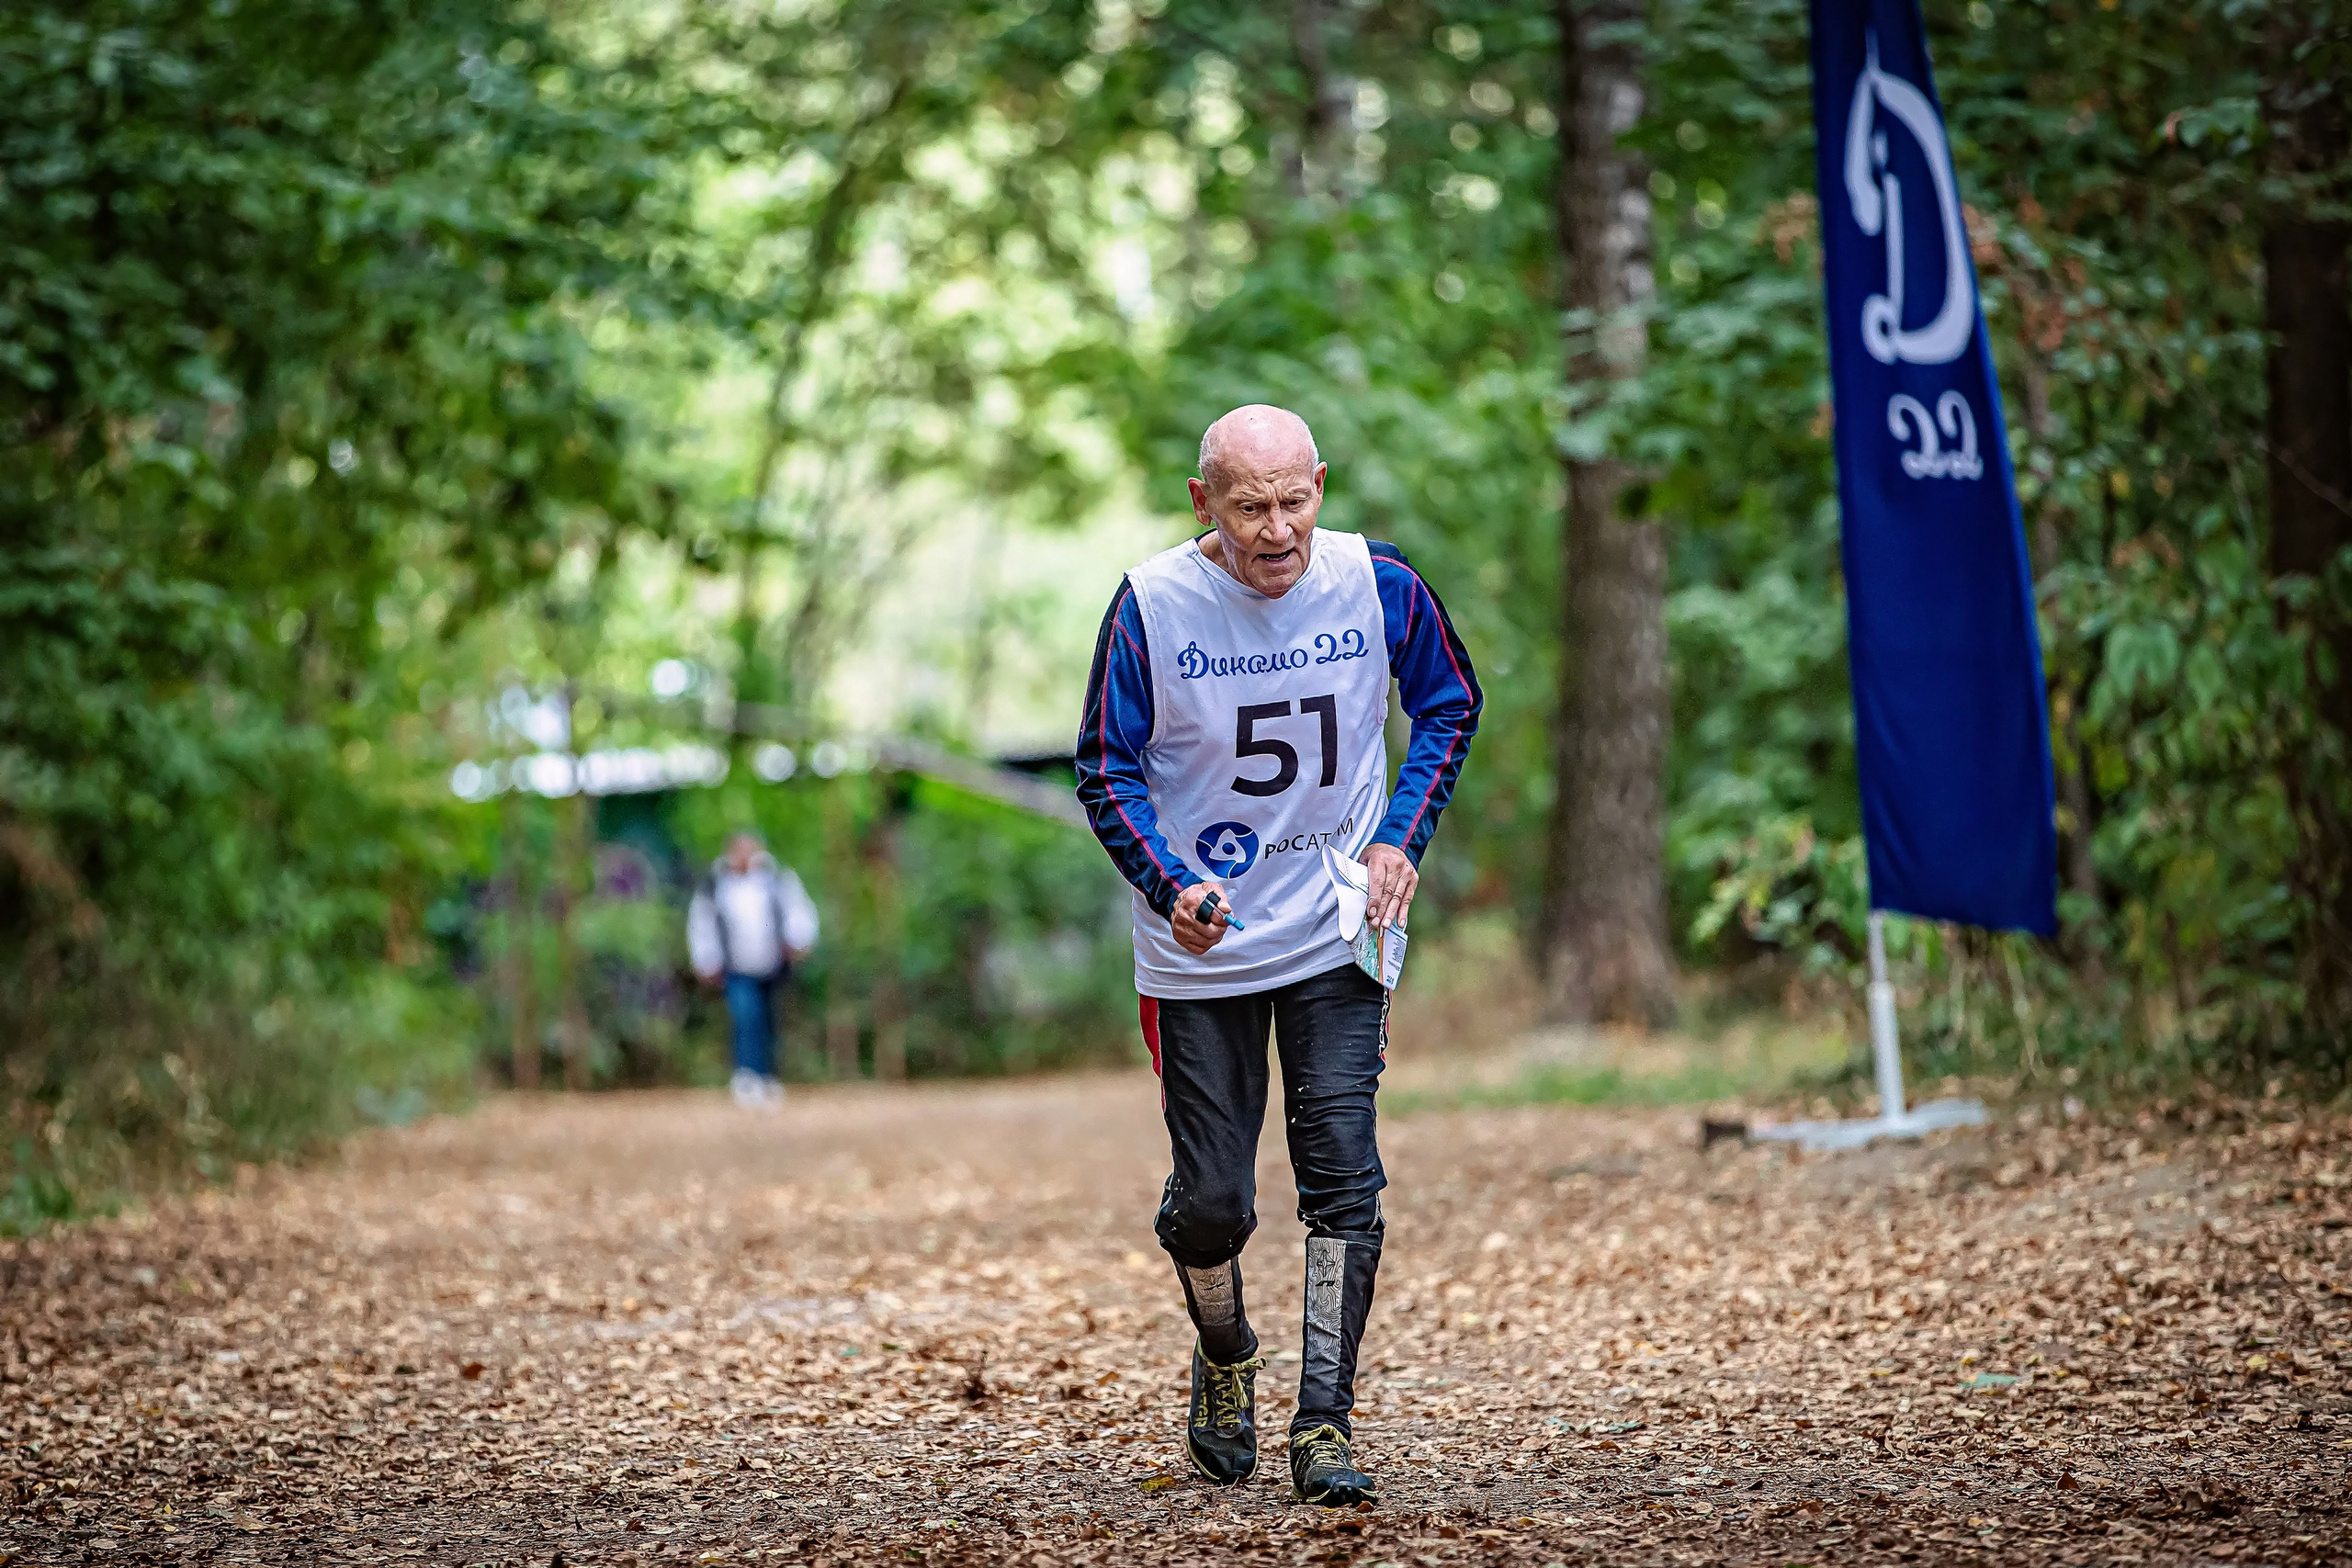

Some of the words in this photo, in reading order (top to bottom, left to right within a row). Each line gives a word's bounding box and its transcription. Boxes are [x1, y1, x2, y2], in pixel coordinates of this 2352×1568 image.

[1887, 389, 1984, 479] 22
[1177, 640, 1308, 680] Динамо
[1314, 628, 1370, 665] 22
[1230, 694, 1339, 797] 51
[1264, 817, 1353, 860] РОСАТМ
